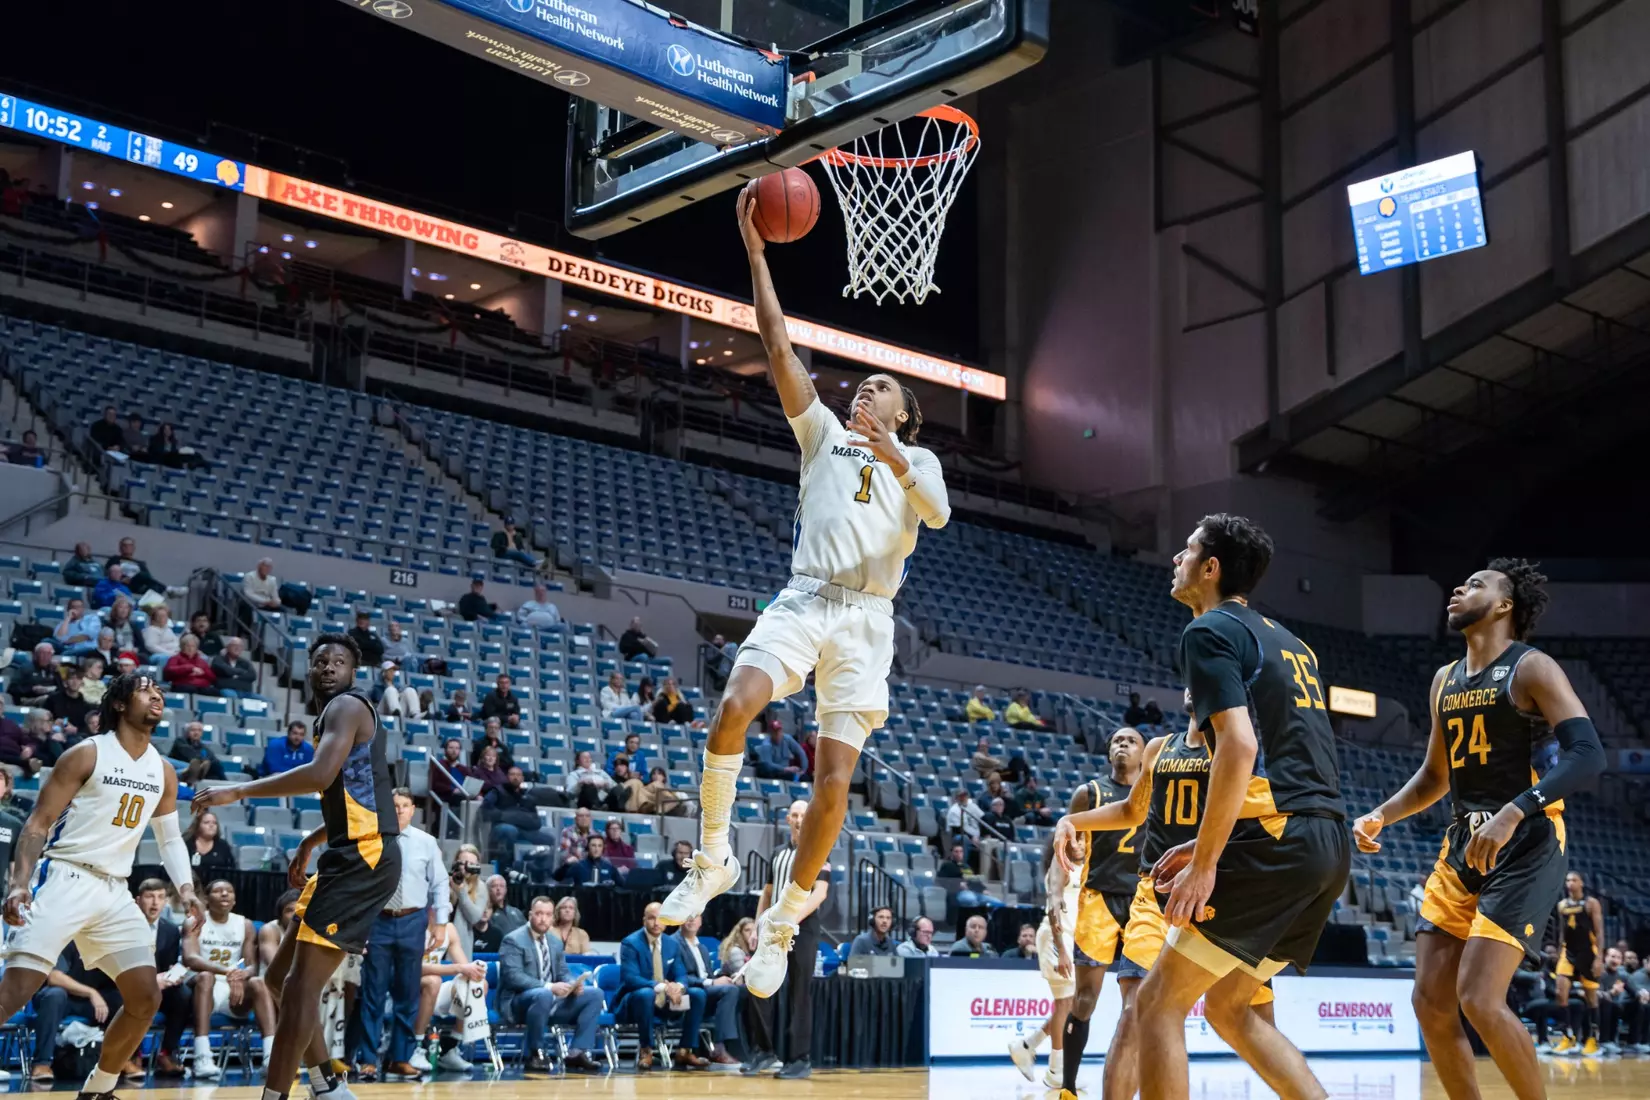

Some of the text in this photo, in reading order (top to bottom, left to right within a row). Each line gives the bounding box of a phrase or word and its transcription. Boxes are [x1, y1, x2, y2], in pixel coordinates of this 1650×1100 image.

[537, 0, 598, 25] Lutheran
[536, 7, 625, 50] Health Network
[465, 29, 562, 72] Health Network
[485, 47, 552, 76] Lutheran
[697, 53, 754, 84] Lutheran
[697, 70, 779, 108] Health Network
[25, 107, 82, 142] 10:52
[97, 125, 107, 139] 2
[650, 110, 710, 134] Lutheran
[683, 111, 721, 130] Health
[132, 149, 141, 161] 3
[134, 136, 142, 147] 4
[173, 151, 199, 173] 49
[281, 182, 479, 250] AXE THROWING
[547, 255, 714, 315] DEADEYE DICKS
[854, 464, 874, 504] 1
[394, 571, 414, 585] 216
[731, 596, 747, 608] 214
[1280, 649, 1326, 710] 35
[1442, 687, 1498, 713] COMMERCE
[1447, 714, 1492, 769] 24
[1157, 758, 1211, 773] COMMERC
[102, 775, 160, 793] MASTODONS
[111, 792, 145, 829] 10
[1164, 778, 1199, 825] 10
[1117, 825, 1138, 853] 2
[970, 997, 1055, 1017] GLENBRO
[1318, 1001, 1394, 1018] GLENBROOK
